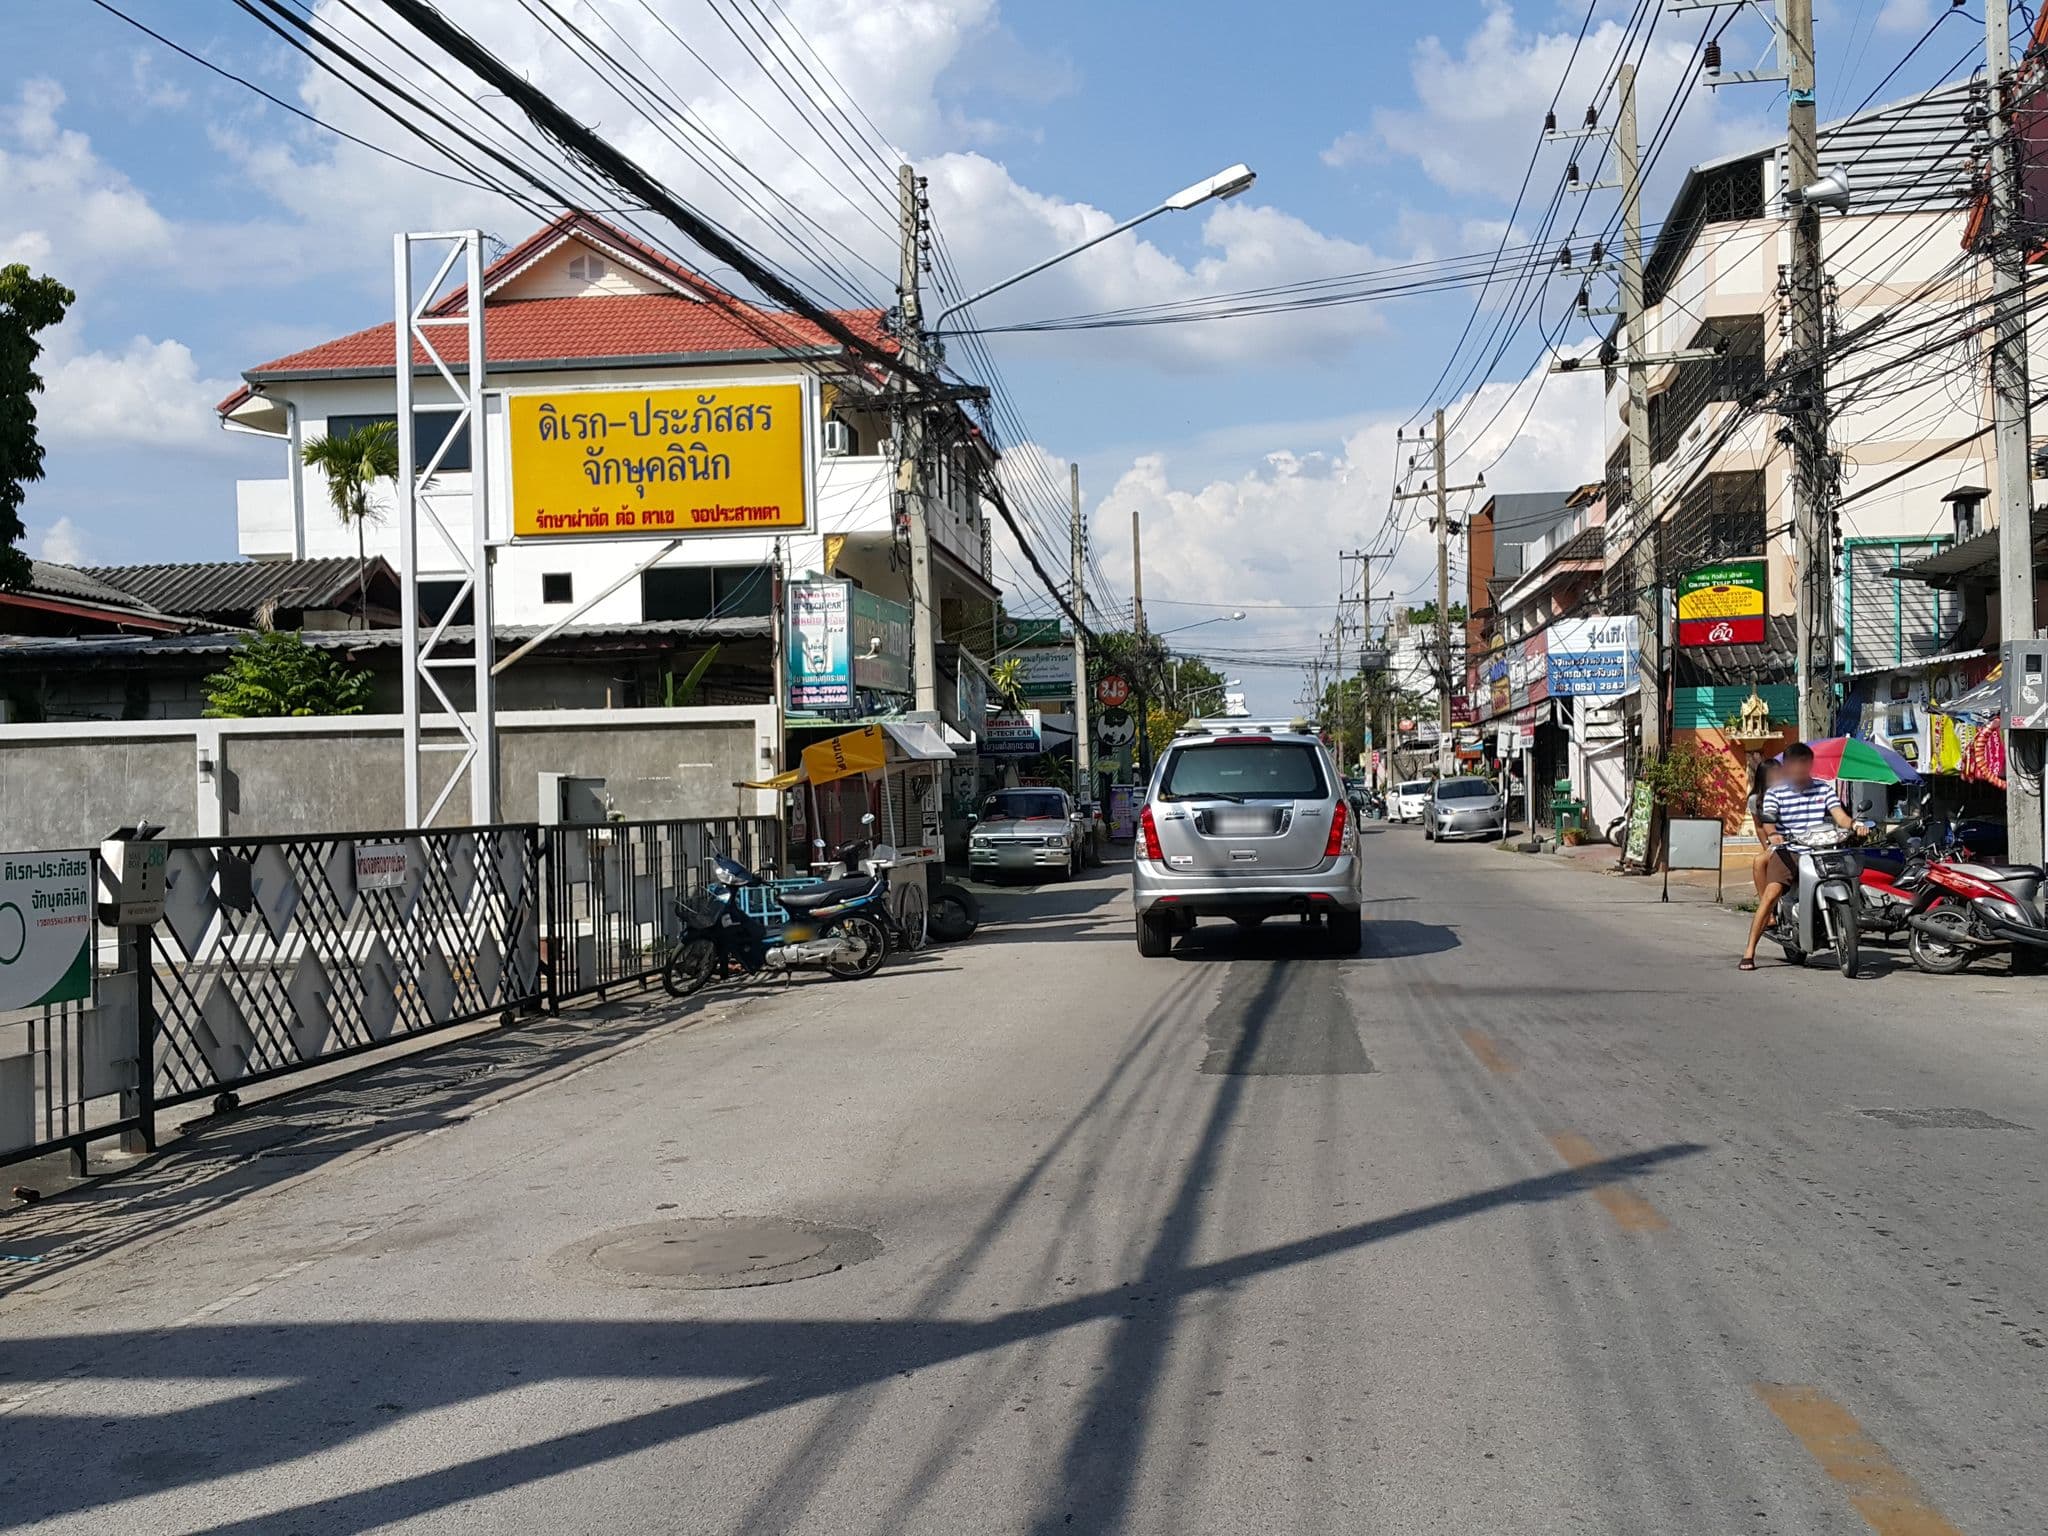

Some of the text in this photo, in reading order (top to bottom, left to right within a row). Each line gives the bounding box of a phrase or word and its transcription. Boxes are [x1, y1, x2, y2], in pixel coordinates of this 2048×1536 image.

[538, 394, 773, 441] ดิเรก-ประภัสสร
[583, 442, 731, 499] จักษุคลินิก
[535, 503, 780, 529] รักษาผ่าตัด ต้อ ตาเข จอประสาทตา
[827, 601, 842, 609] CAR
[952, 767, 974, 777] LPG
[4, 857, 87, 881] ดิเรก-ประภัสสร
[31, 887, 87, 912] จักษุคลินิก
